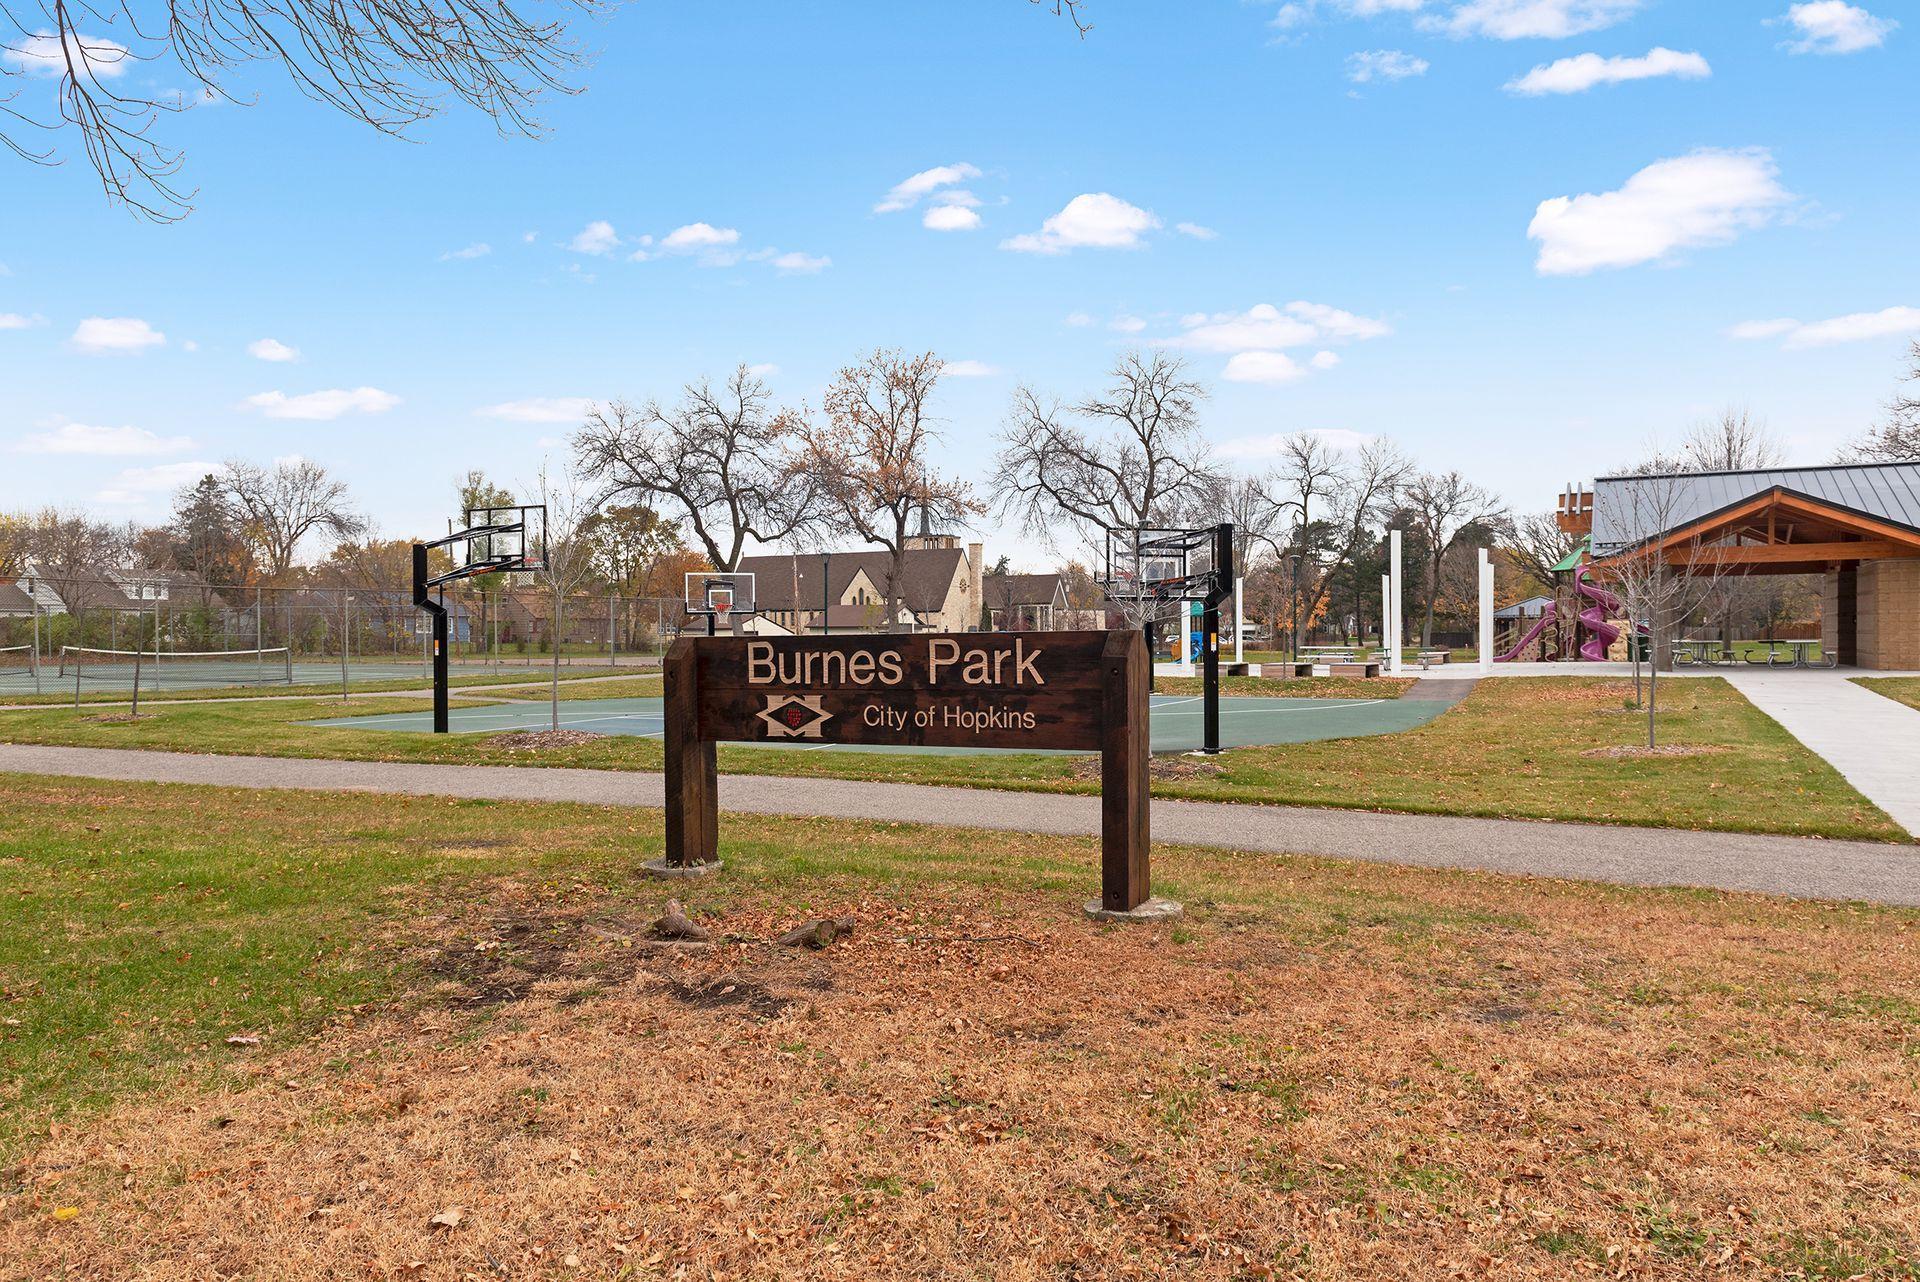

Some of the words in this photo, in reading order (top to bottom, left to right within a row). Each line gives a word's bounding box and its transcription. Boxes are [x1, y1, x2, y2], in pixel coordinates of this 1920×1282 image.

[747, 641, 903, 685] Burnes
[928, 638, 1045, 685] Park
[863, 705, 908, 731] City
[914, 705, 936, 728] of
[943, 706, 1036, 734] Hopkins
